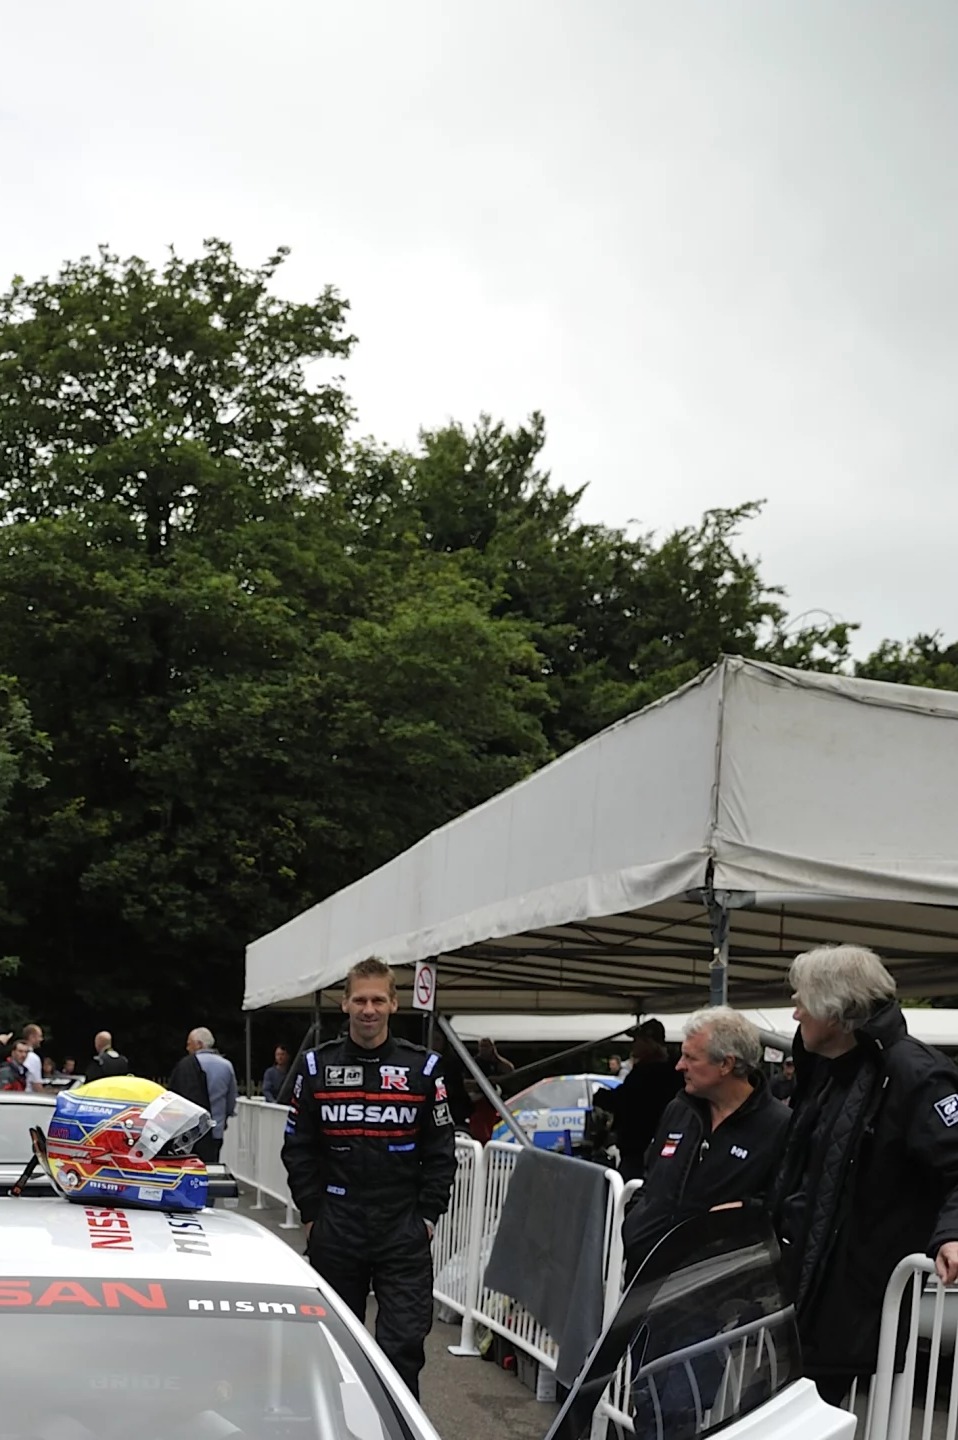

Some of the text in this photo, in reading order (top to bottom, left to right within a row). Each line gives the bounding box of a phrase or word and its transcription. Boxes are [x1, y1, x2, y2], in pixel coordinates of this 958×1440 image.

[77, 1104, 113, 1115] NISSAN
[321, 1104, 418, 1124] NISSAN
[83, 1205, 134, 1251] NISS
[188, 1299, 326, 1317] nismo
